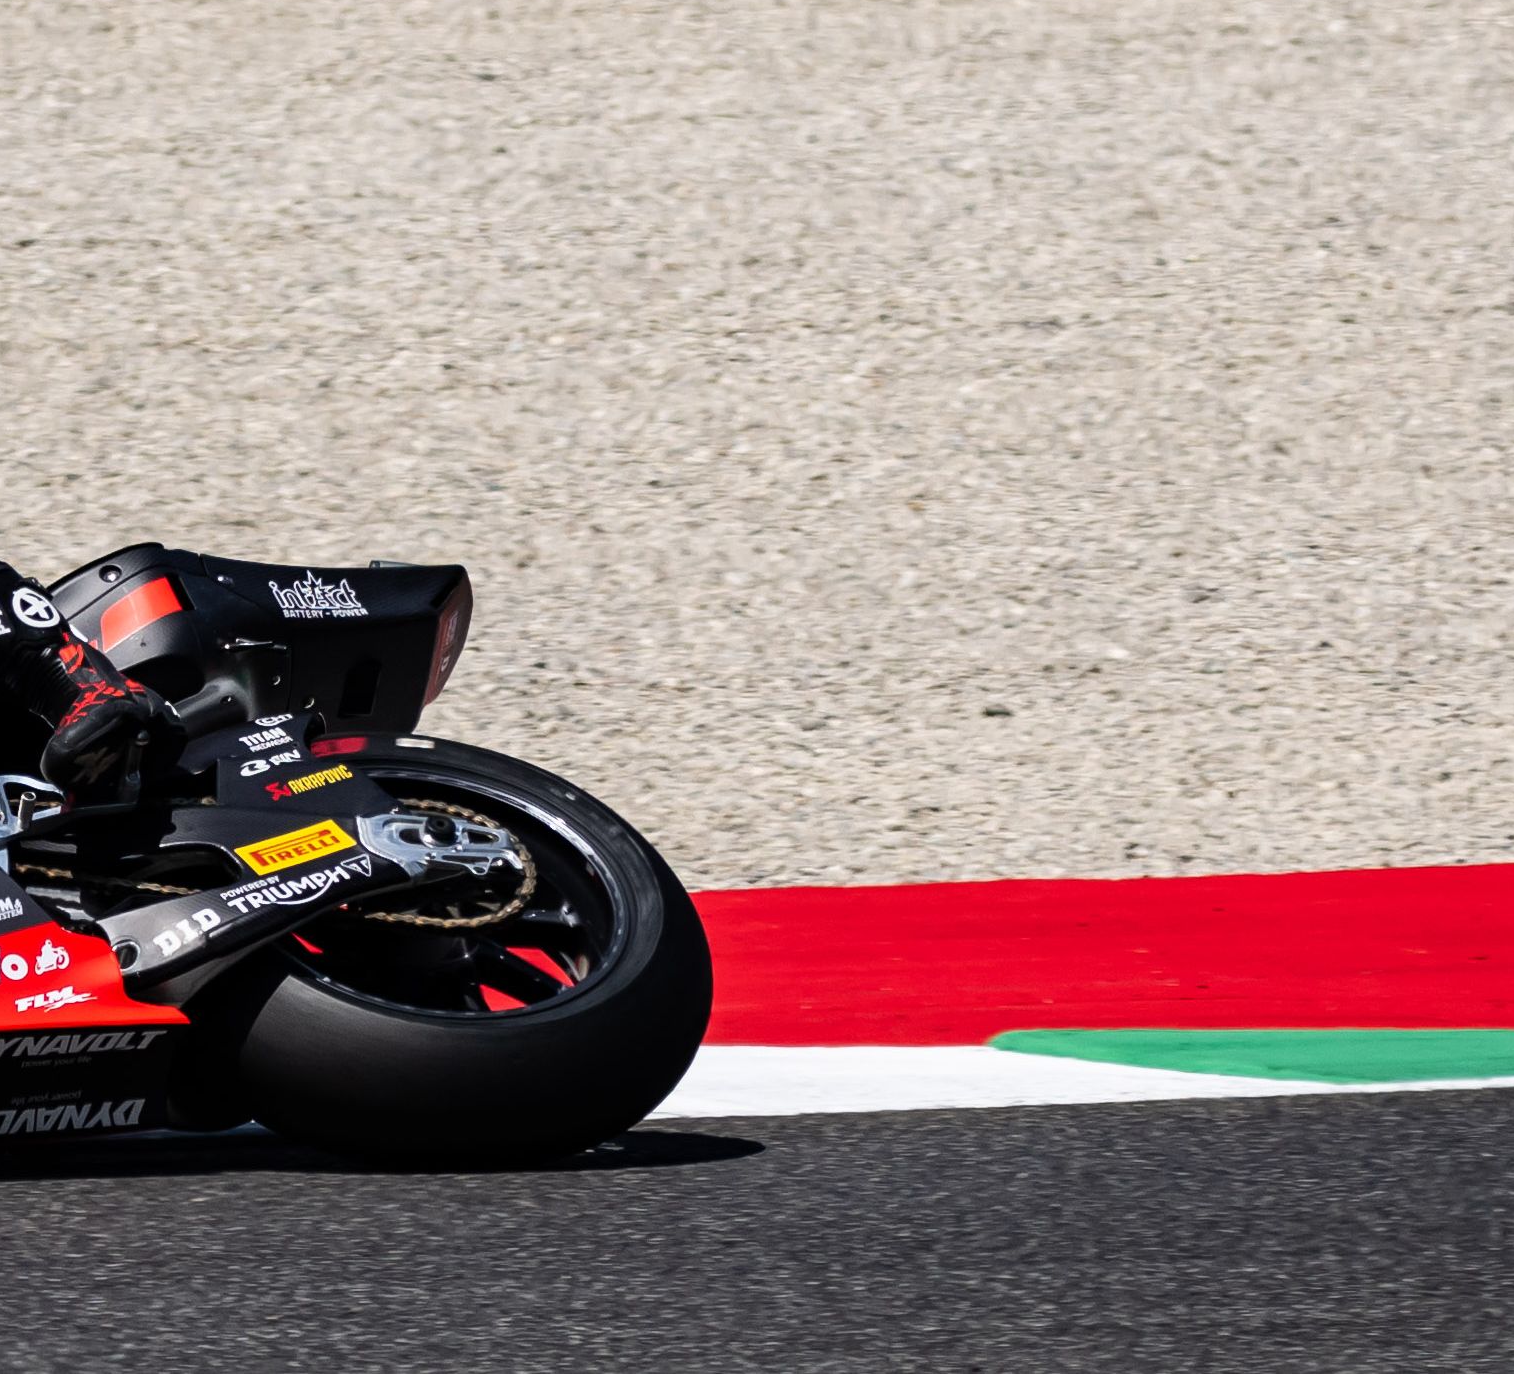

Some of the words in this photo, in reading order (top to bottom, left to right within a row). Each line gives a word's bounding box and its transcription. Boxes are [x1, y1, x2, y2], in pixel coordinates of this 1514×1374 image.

[283, 609, 323, 618] BATTERY
[332, 608, 369, 617] POWER
[239, 727, 287, 746] TITAN
[250, 829, 341, 867] PIRELLI
[220, 879, 266, 900] POWERED
[267, 876, 280, 888] BY
[227, 866, 351, 913] TRIUMPH
[15, 985, 74, 1012] FLM
[21, 1058, 52, 1068] power
[54, 1058, 73, 1067] your
